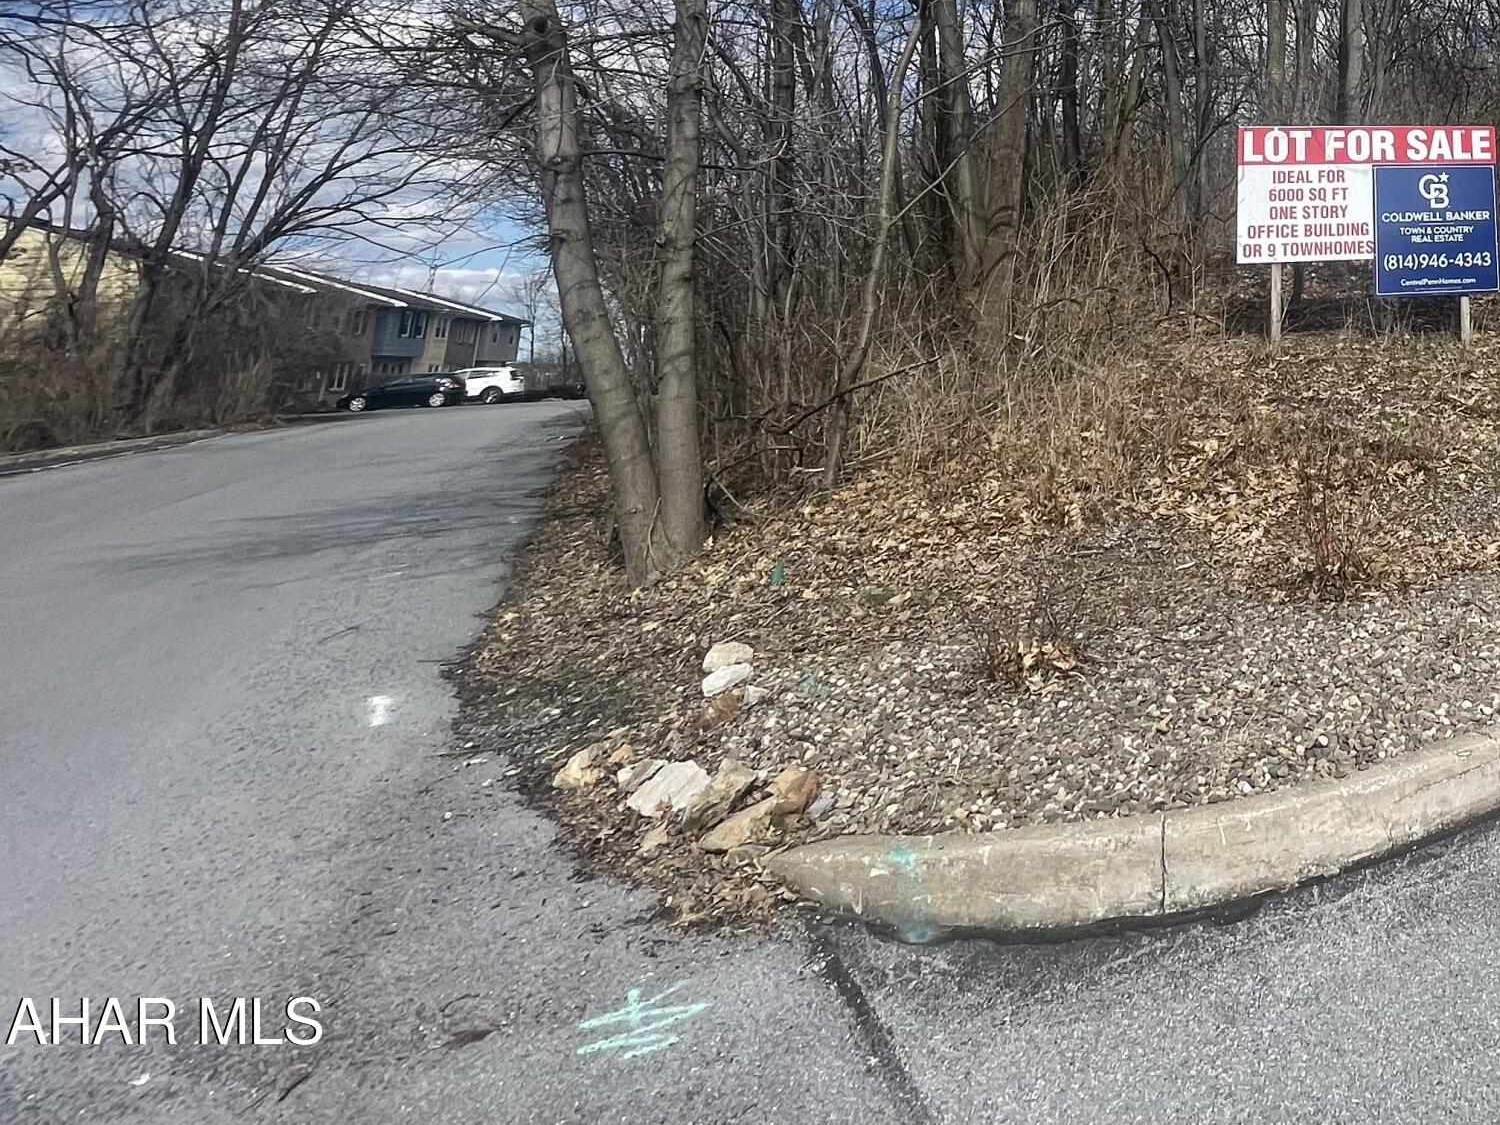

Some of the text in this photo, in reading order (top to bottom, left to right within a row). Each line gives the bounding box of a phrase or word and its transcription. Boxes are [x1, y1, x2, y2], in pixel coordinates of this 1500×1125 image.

[1243, 128, 1492, 163] LOT FOR SALE
[1272, 170, 1345, 184] IDEAL FOR
[1268, 187, 1349, 202] 6000 SQ FT
[1269, 205, 1348, 220] ONE STORY
[1381, 211, 1490, 223] COLDWELL BANKER
[1247, 222, 1369, 239] OFFICE BUILDING
[1399, 225, 1474, 235] TOWN & COUNTRY
[1411, 234, 1464, 243] REAL ESTATE
[1242, 240, 1375, 258] OR 9 TOWNHOMES
[1383, 251, 1492, 272] (814)946-4343
[1400, 277, 1476, 287] CentralPennHomes.com
